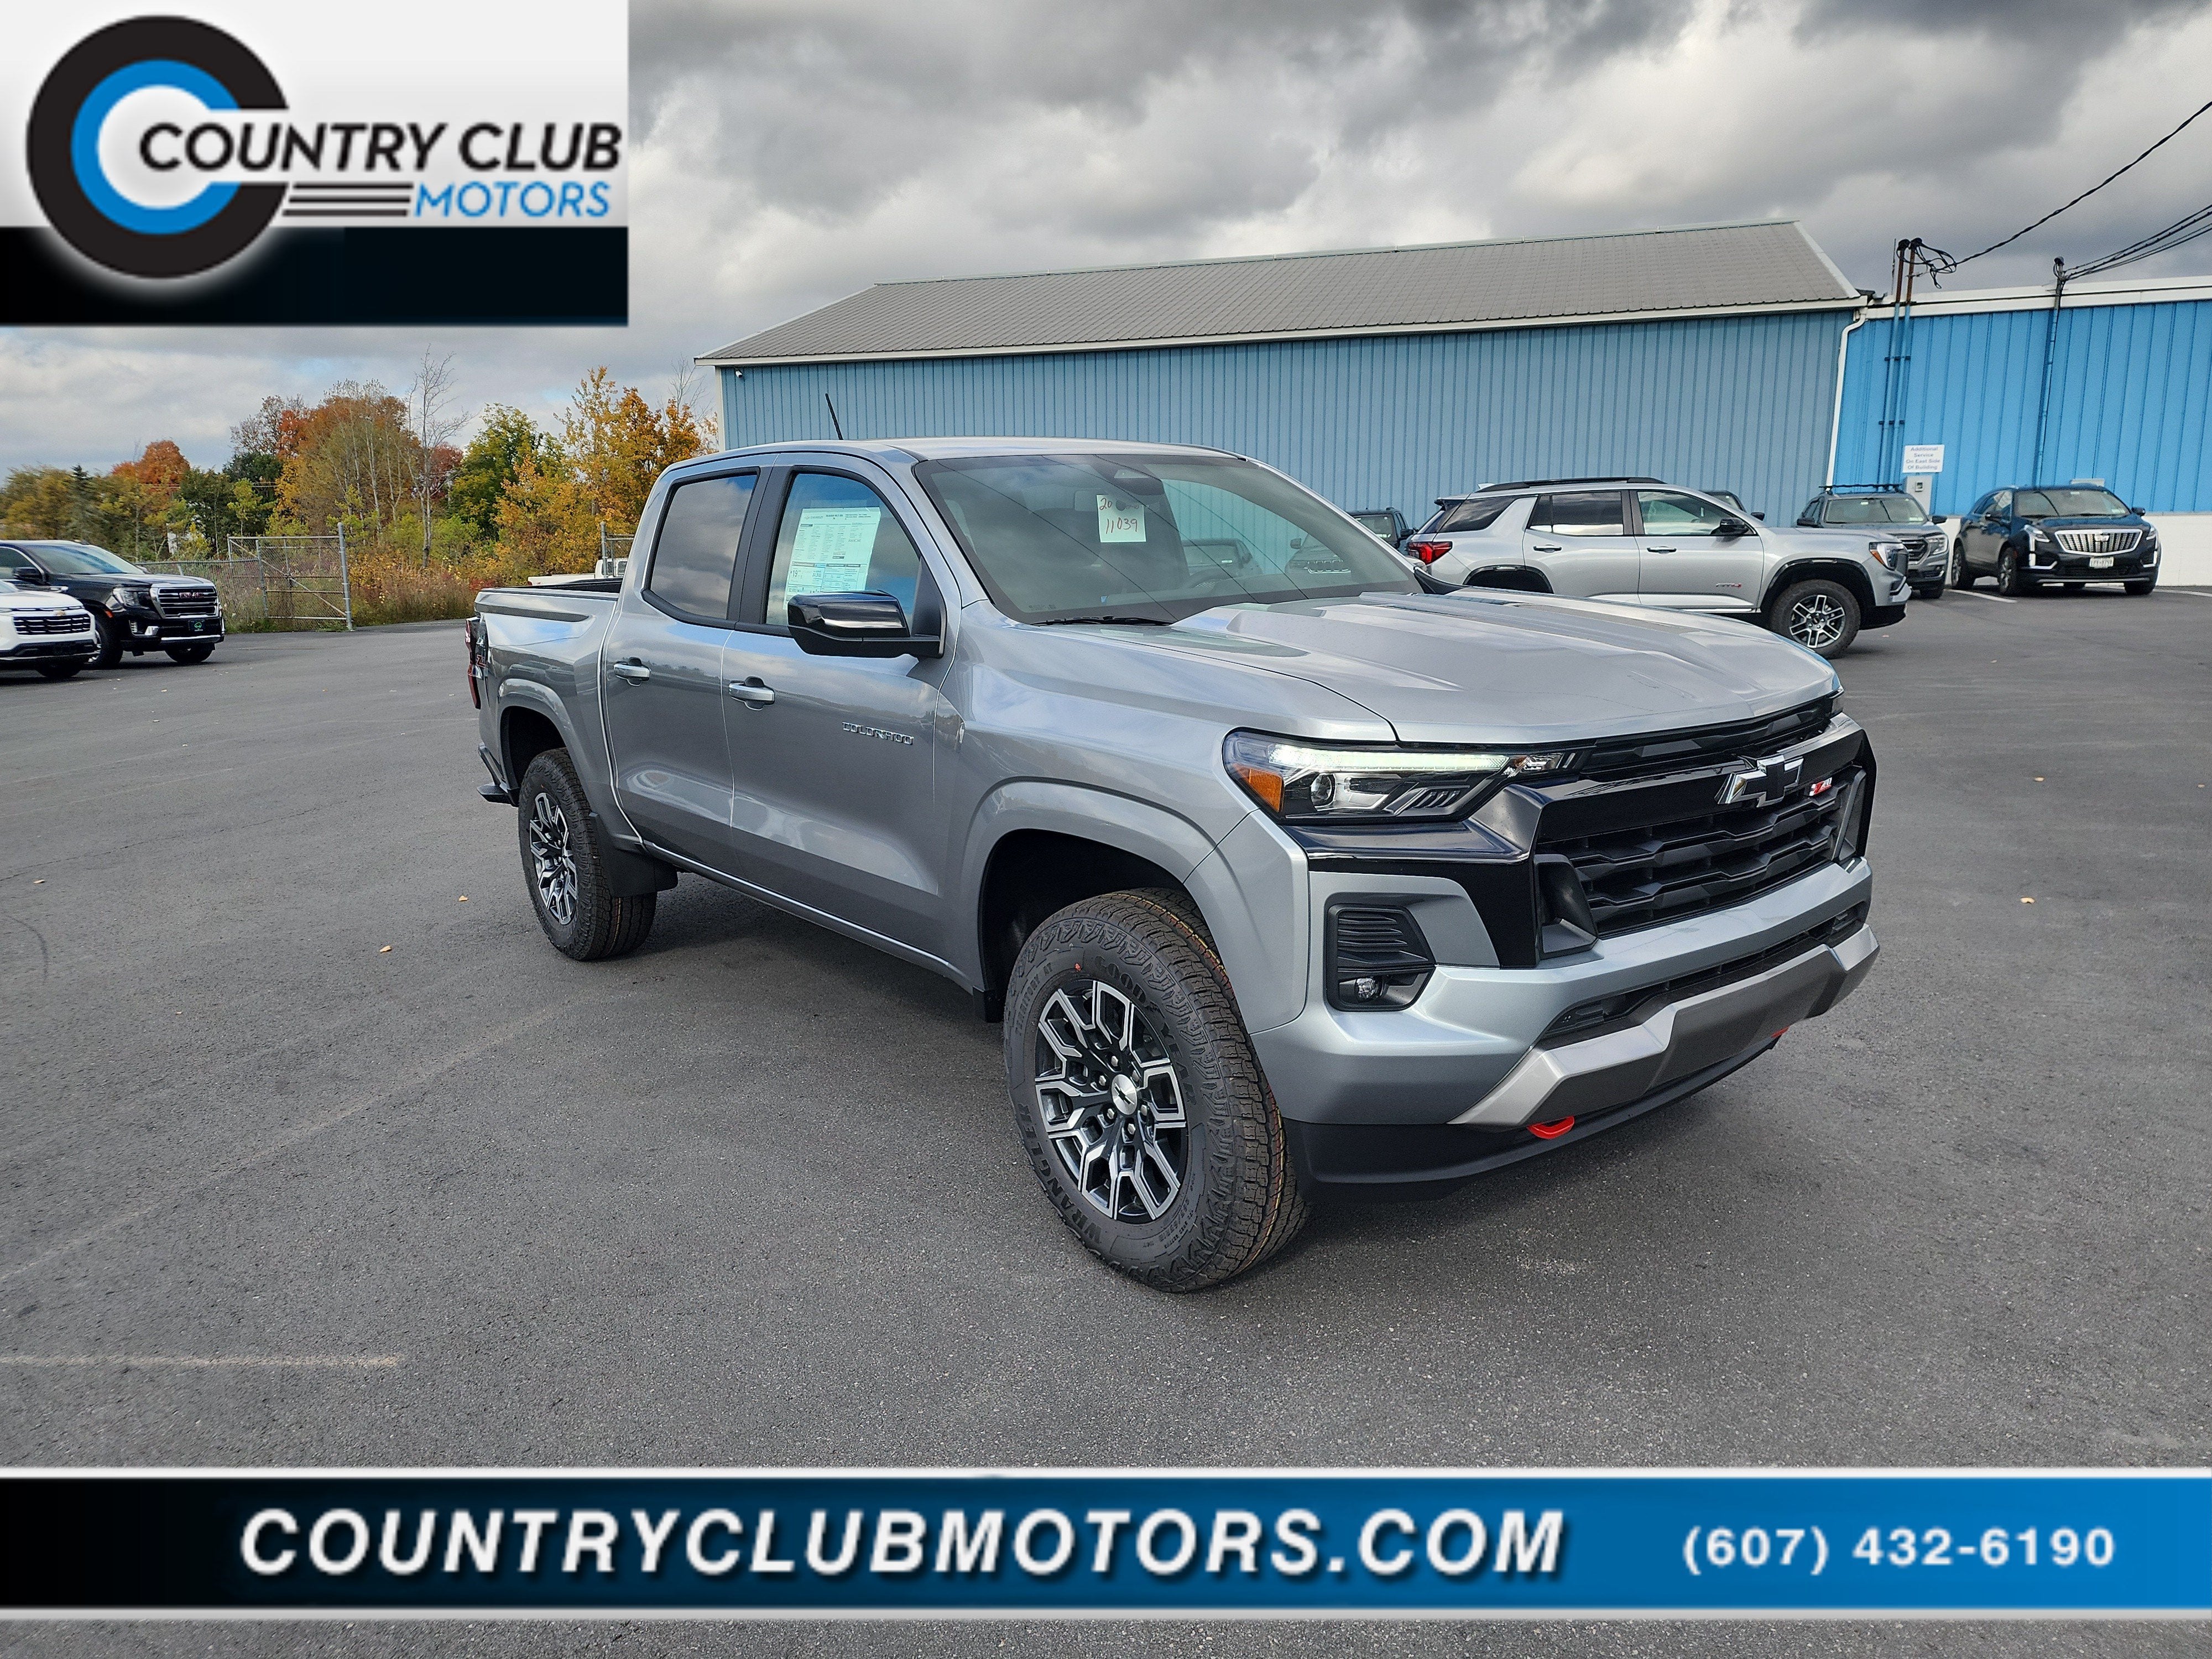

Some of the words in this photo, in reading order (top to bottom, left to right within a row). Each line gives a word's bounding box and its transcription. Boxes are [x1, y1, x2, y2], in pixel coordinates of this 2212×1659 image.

[1106, 517, 1138, 534] 11039
[842, 722, 914, 745] COLORADO
[1094, 955, 1197, 1105] GOODYEAR
[1018, 1103, 1102, 1243] WRANGLER
